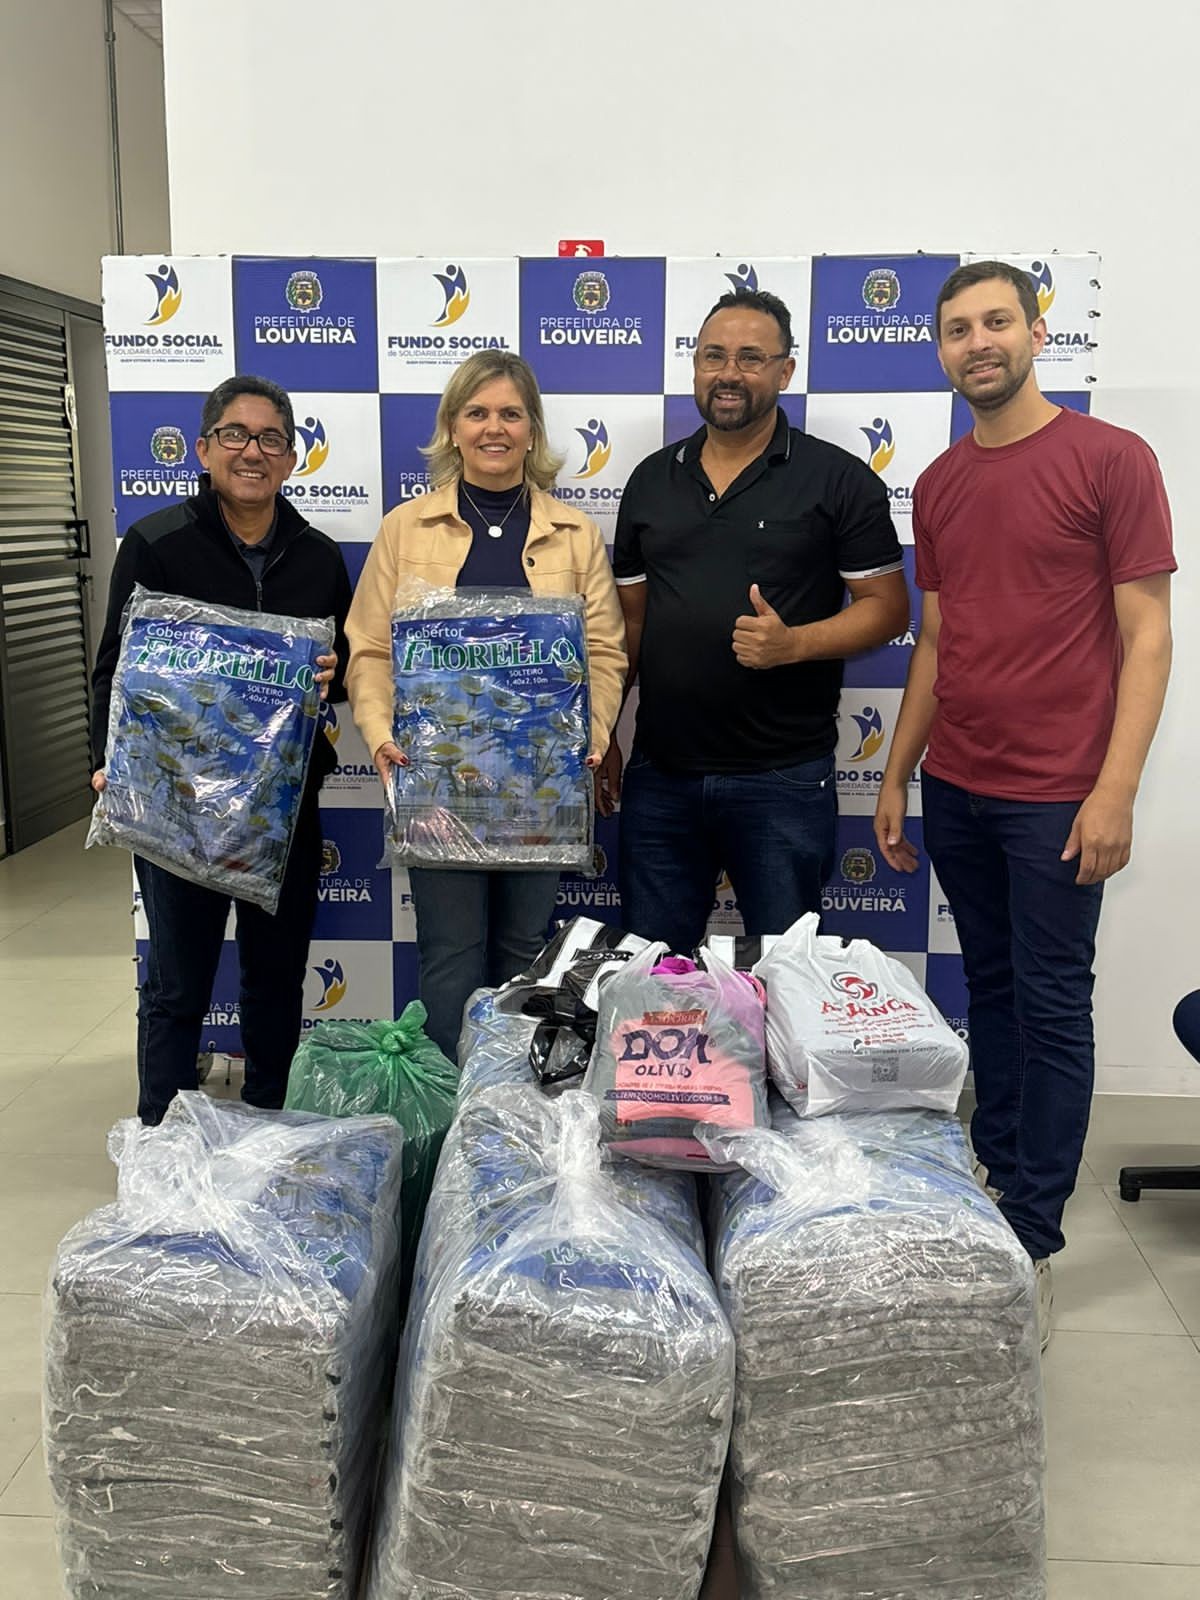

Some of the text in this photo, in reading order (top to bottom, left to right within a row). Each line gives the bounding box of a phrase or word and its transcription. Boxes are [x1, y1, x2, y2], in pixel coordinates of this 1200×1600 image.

[255, 316, 355, 328] PREFEITURA DE
[540, 317, 642, 328] PREFEITURA DE
[827, 314, 932, 326] PREFEITURA DE
[104, 335, 223, 347] FUNDO SOCIAL
[255, 328, 357, 344] LOUVEIRA
[540, 329, 642, 345] LOUVEIRA
[827, 327, 932, 343] LOUVEIRA
[1044, 333, 1089, 346] OCIAL
[388, 336, 510, 349] FUNDO SOCIAL
[113, 348, 172, 356] SOLIDARIEDADE
[184, 348, 224, 356] LOUVEIRA
[120, 470, 199, 480] PREFEITURA
[121, 481, 200, 496] LOUVEI
[309, 485, 369, 498] SOCIAL
[552, 487, 622, 500] NDO SOC
[406, 627, 465, 641] Cobertor
[509, 667, 544, 678] SOLTEIRO
[247, 684, 284, 698] SOLTEIRO
[332, 764, 378, 776] OCIAL
[354, 879, 371, 888] DE
[559, 882, 617, 891] EFEITURA
[317, 888, 372, 902] VEIRA
[556, 892, 622, 906] OUVEIR
[821, 887, 906, 898] EFEITURA DE
[822, 897, 906, 912] OUVEIRA
[203, 1013, 241, 1026] EIRA
